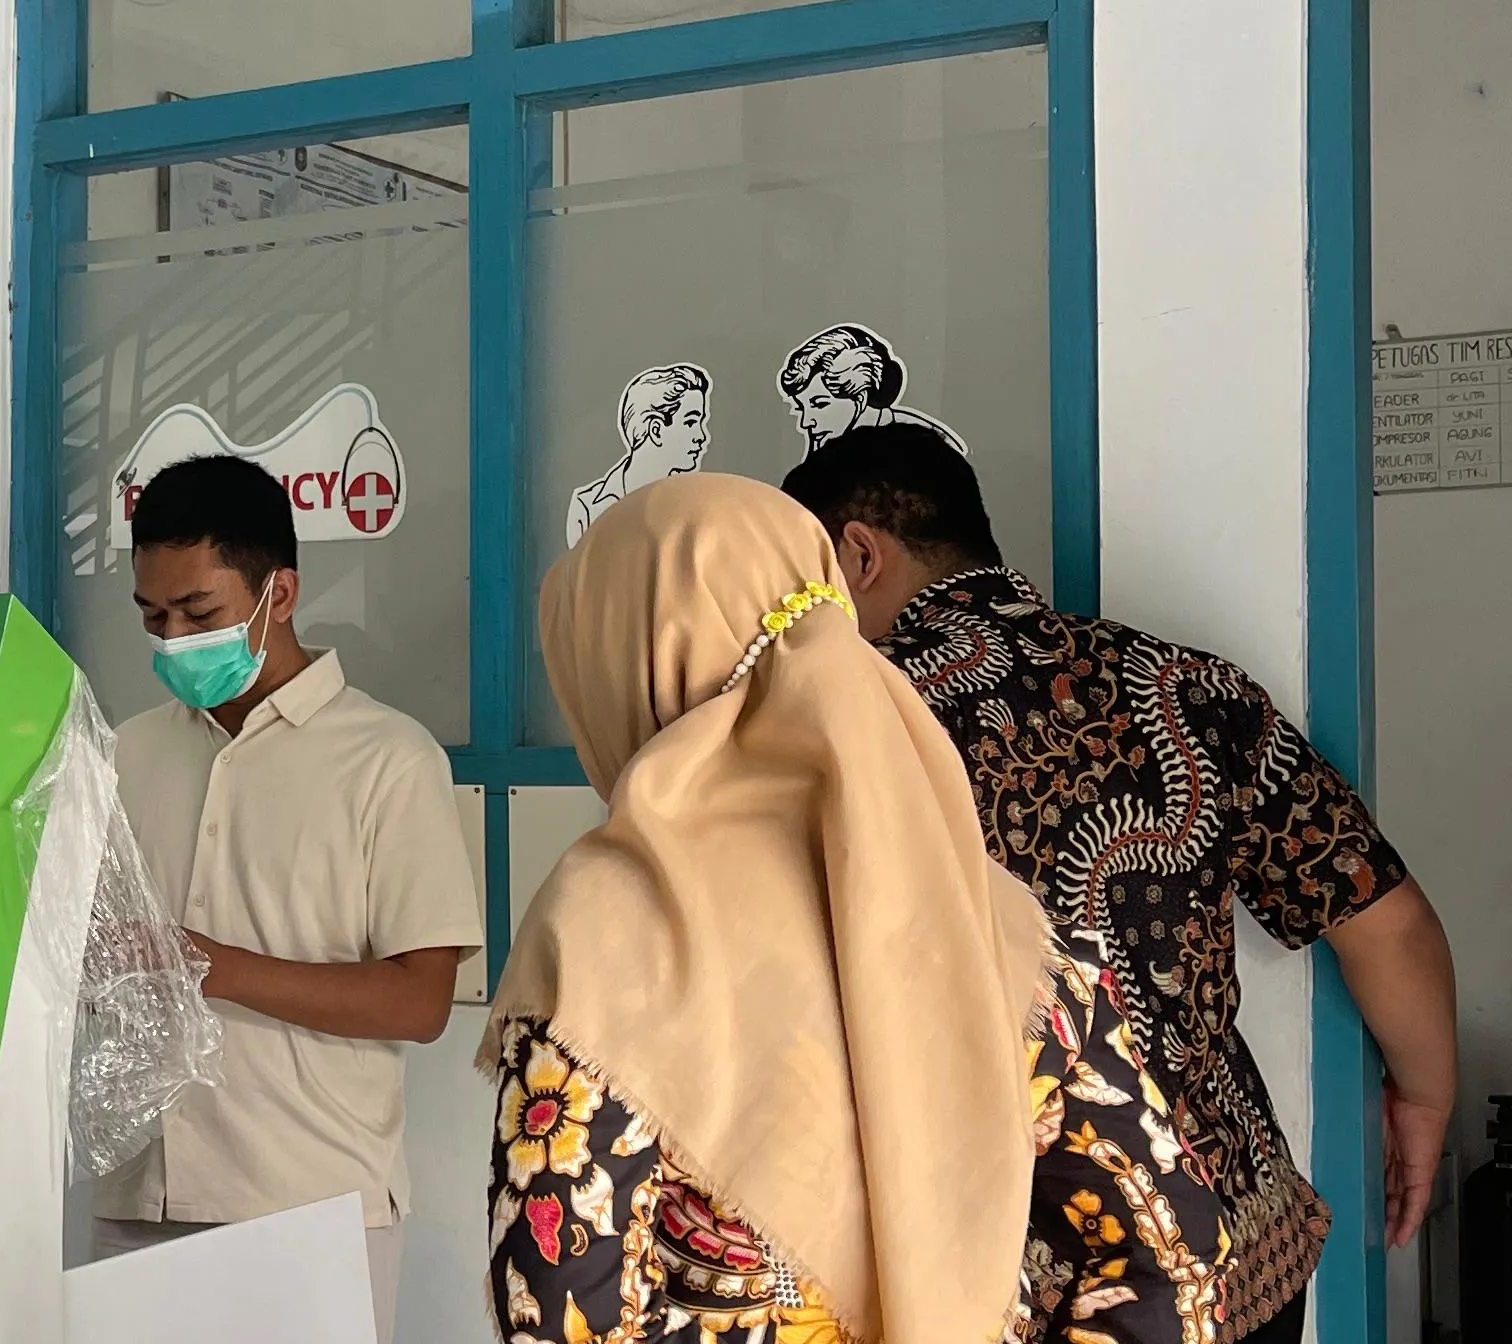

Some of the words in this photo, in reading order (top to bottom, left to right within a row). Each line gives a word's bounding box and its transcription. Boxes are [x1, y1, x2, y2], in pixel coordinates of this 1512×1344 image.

[1447, 339, 1481, 363] TIM
[1450, 371, 1484, 384] PAGI
[1374, 393, 1420, 408] EADER
[1372, 412, 1433, 427] ENTILATOR
[1373, 431, 1431, 447] OMPRESOR
[1375, 453, 1434, 469] RKULATOR
[1373, 471, 1437, 487] OKUMENTASI
